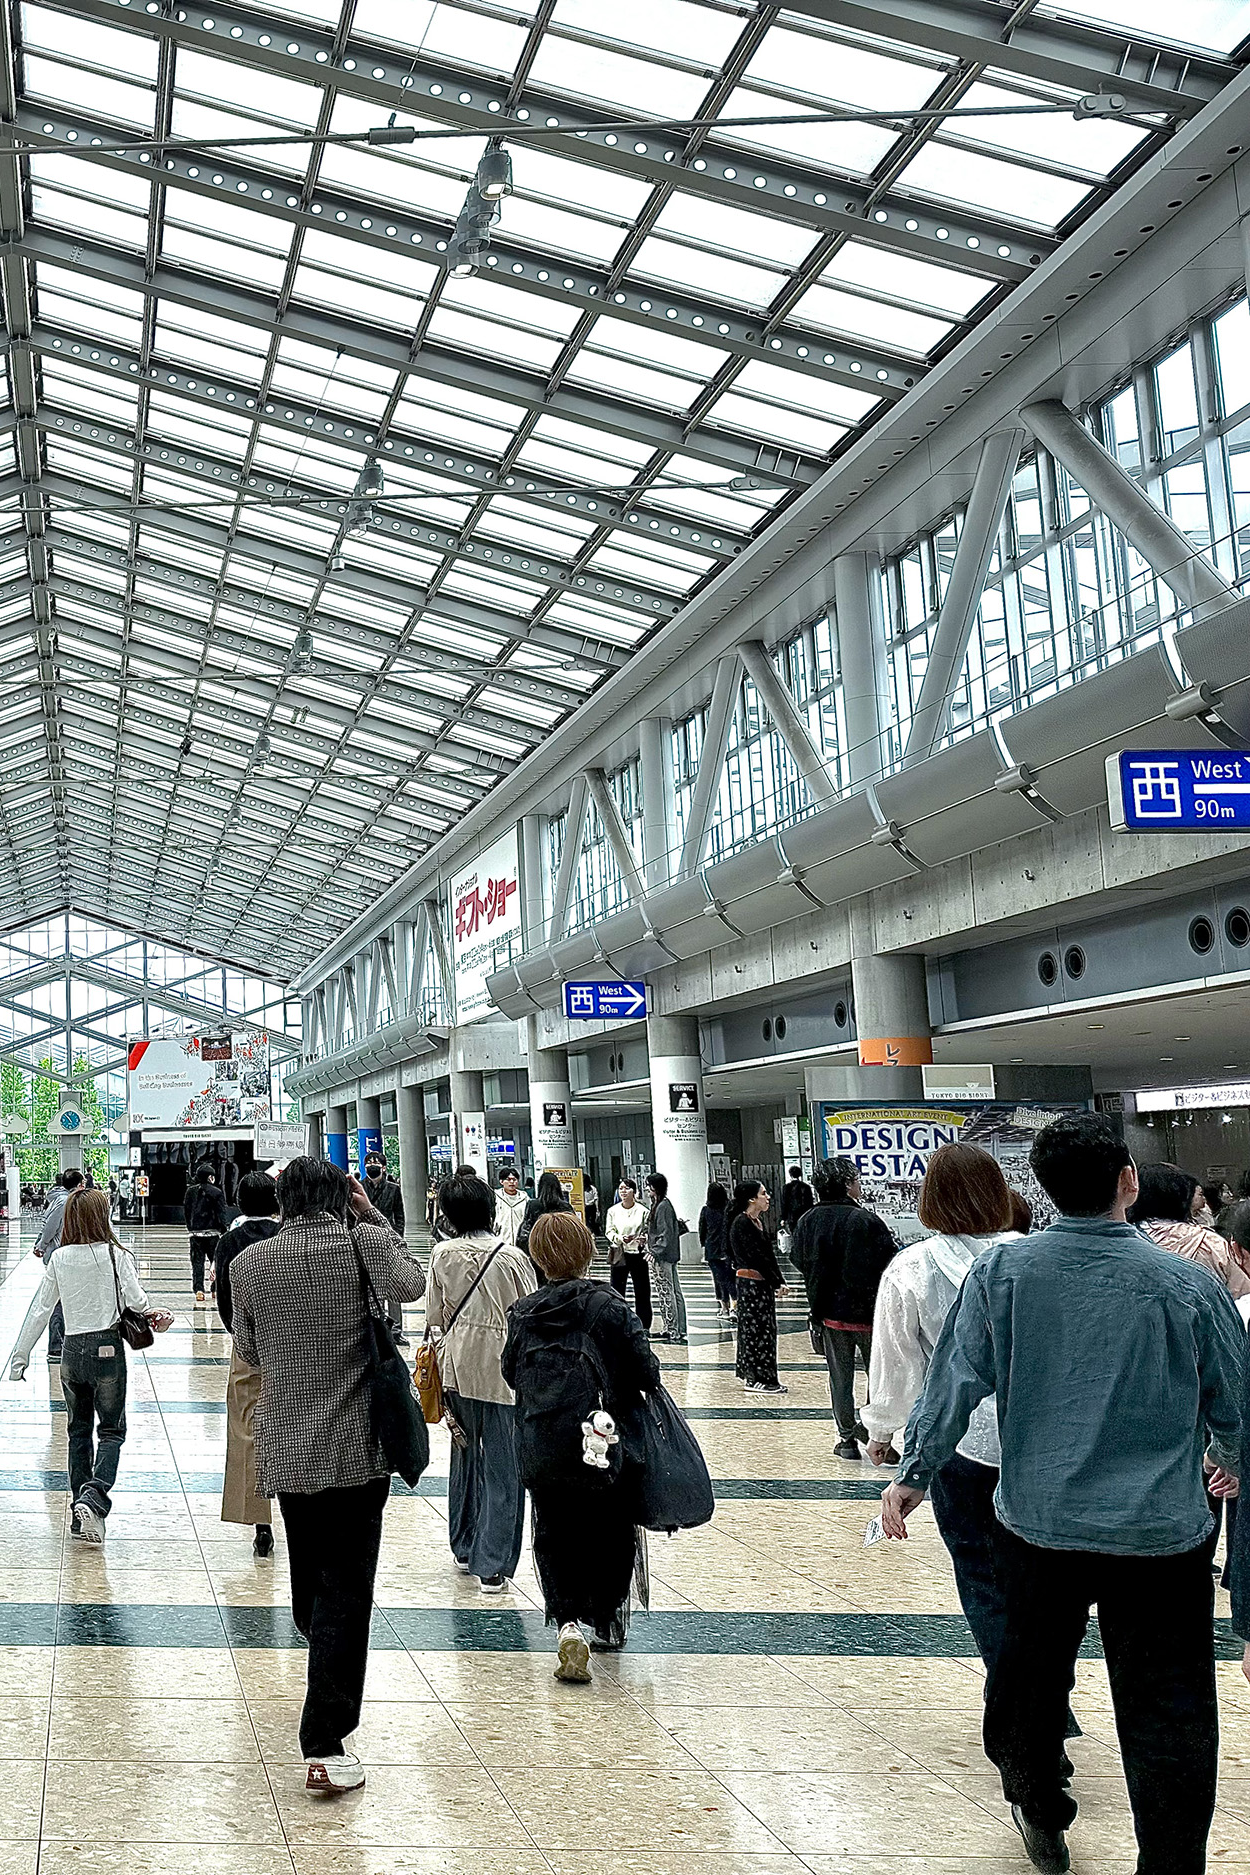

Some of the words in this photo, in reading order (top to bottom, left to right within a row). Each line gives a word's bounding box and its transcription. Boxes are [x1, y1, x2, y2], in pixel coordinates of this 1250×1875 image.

[1190, 760, 1243, 779] West
[1129, 762, 1182, 818] 西
[1194, 799, 1235, 818] 90m
[598, 985, 623, 995] West
[569, 986, 594, 1014] 西
[598, 1004, 619, 1014] 90m
[844, 1110, 904, 1121] INTERNATIONAL
[923, 1112, 949, 1120] EVENT
[836, 1127, 954, 1150] DESIGN
[837, 1154, 927, 1177] ESTA
